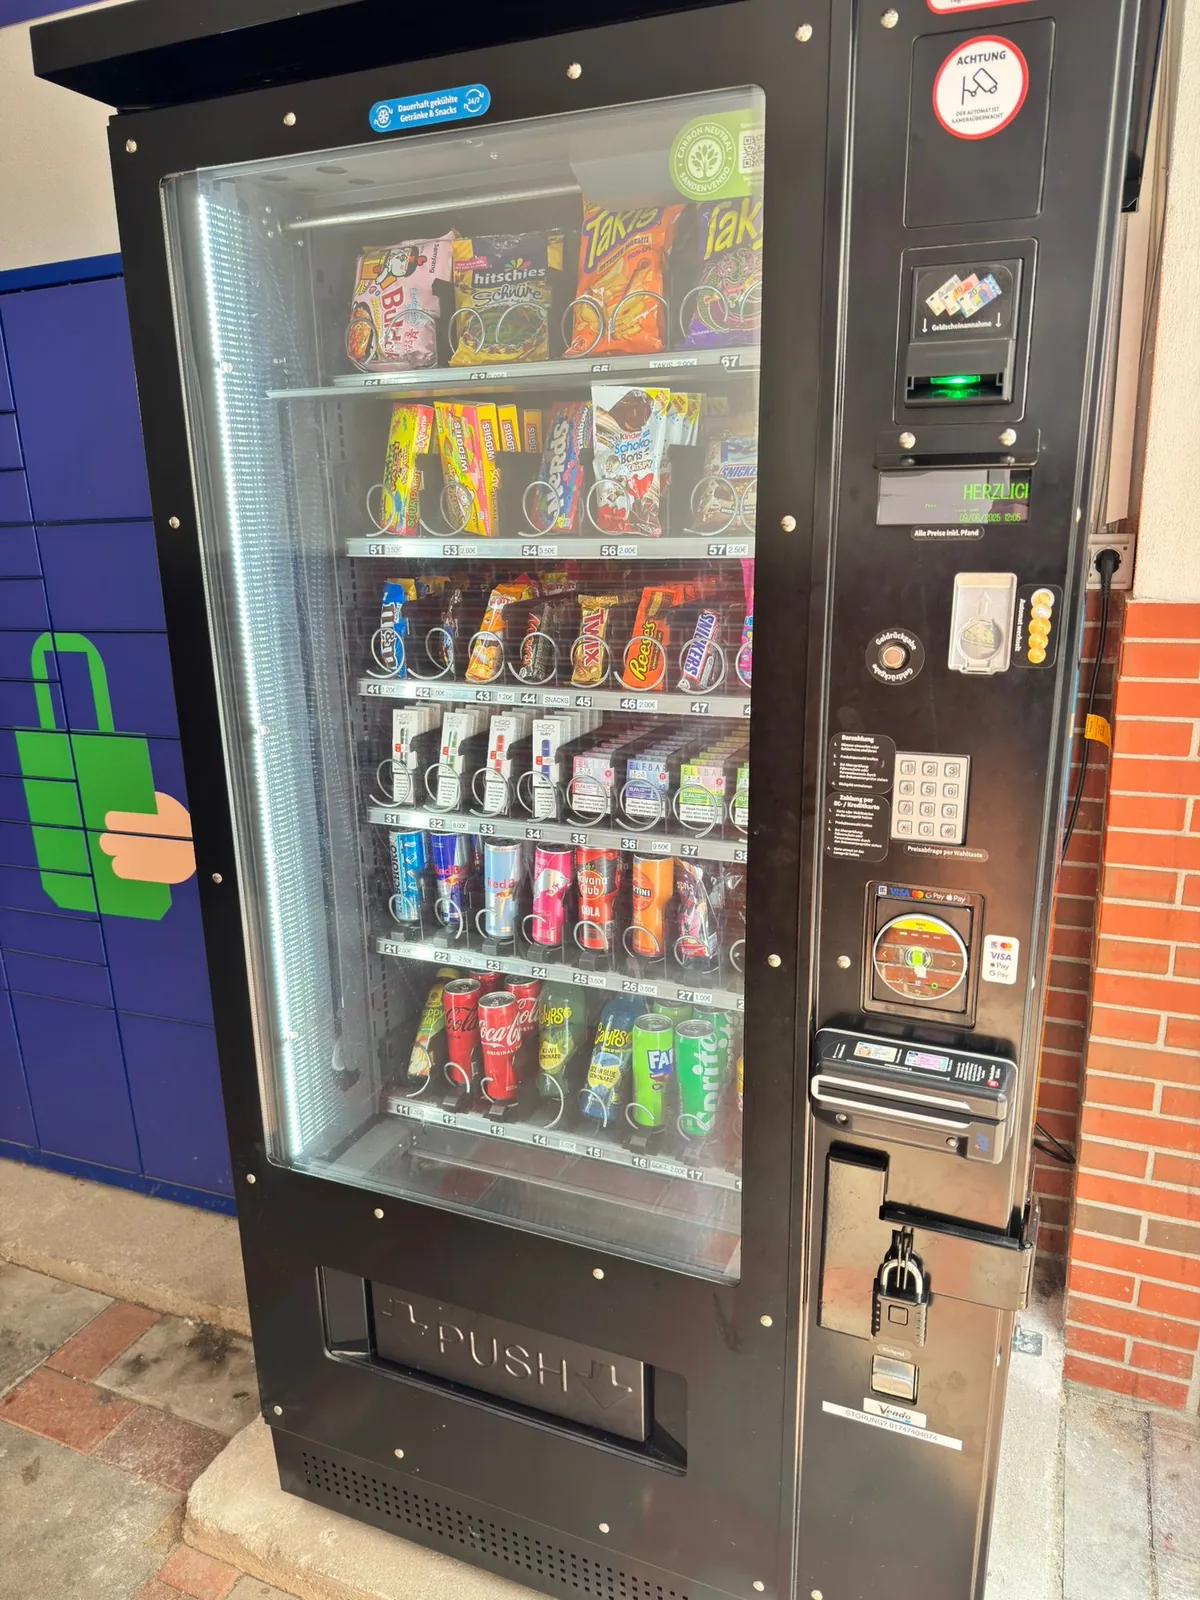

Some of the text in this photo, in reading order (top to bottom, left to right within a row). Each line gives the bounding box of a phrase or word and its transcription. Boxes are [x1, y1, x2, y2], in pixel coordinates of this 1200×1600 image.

[957, 50, 1007, 66] ACHTUNG
[398, 95, 458, 113] Dauerhaft gekühlte
[467, 97, 480, 105] 24/7
[400, 106, 457, 123] Getränke & Snacks
[967, 107, 991, 116] AUTOMAT
[677, 125, 733, 158] CARBON NEUTRAL
[679, 166, 730, 192] SANDENVENDO
[474, 268, 546, 285] hitschies
[931, 321, 992, 332] Geldscheinannahme
[721, 356, 739, 367] 67
[578, 407, 589, 450] rainbow
[482, 420, 495, 461] WEDGIES
[454, 422, 468, 471] WEDGIES
[620, 451, 643, 464] Bons
[627, 459, 653, 472] CRISPY
[914, 528, 980, 537] Alle Preise inkl. Pfand
[370, 545, 383, 554] 51
[443, 546, 476, 555] 53 2.00€
[522, 545, 556, 555] 54 3.50€
[601, 545, 636, 556] 56 2.00€
[709, 544, 747, 555] 57 2.50€
[1017, 598, 1026, 625] Automat
[875, 631, 917, 651] Geldrückgabe
[872, 663, 914, 682] Geldrückgabe
[368, 684, 380, 693] 41
[416, 688, 445, 697] 42 2.00€
[476, 691, 490, 700] 43
[521, 693, 569, 704] 44 SNACKS
[576, 696, 591, 706] 45
[621, 699, 655, 708] 46 2.00€
[692, 702, 707, 712] 47
[385, 814, 398, 823] 31
[430, 818, 443, 828] 32
[480, 824, 494, 833] 33
[526, 829, 541, 838] 34
[572, 833, 586, 843] 35
[622, 839, 636, 849] 36
[682, 845, 697, 855] 37
[907, 846, 983, 859] Preisabfrage per Wahltaste
[580, 884, 599, 896] Club
[889, 888, 910, 897] VISA
[933, 893, 945, 901] Pay
[953, 894, 966, 903] Pay
[581, 905, 600, 917] COLA
[385, 945, 397, 953] 21
[435, 953, 448, 961] 22
[990, 952, 1012, 962] VISA
[488, 961, 500, 969] 23
[996, 962, 1010, 970] Pay
[533, 968, 546, 977] 24
[997, 971, 1009, 979] Pay
[574, 974, 604, 985] 25 3.50€
[623, 982, 655, 993] 26 3.50€
[678, 991, 692, 1000] 27
[397, 1106, 409, 1114] 11
[444, 1116, 456, 1124] 12
[491, 1127, 504, 1135] 13
[533, 1136, 546, 1145] 14
[588, 1147, 601, 1156] 15
[634, 1158, 647, 1168] 16
[690, 1171, 703, 1180] 17
[437, 1322, 567, 1392] PUSH
[878, 1404, 912, 1420] Vendo
